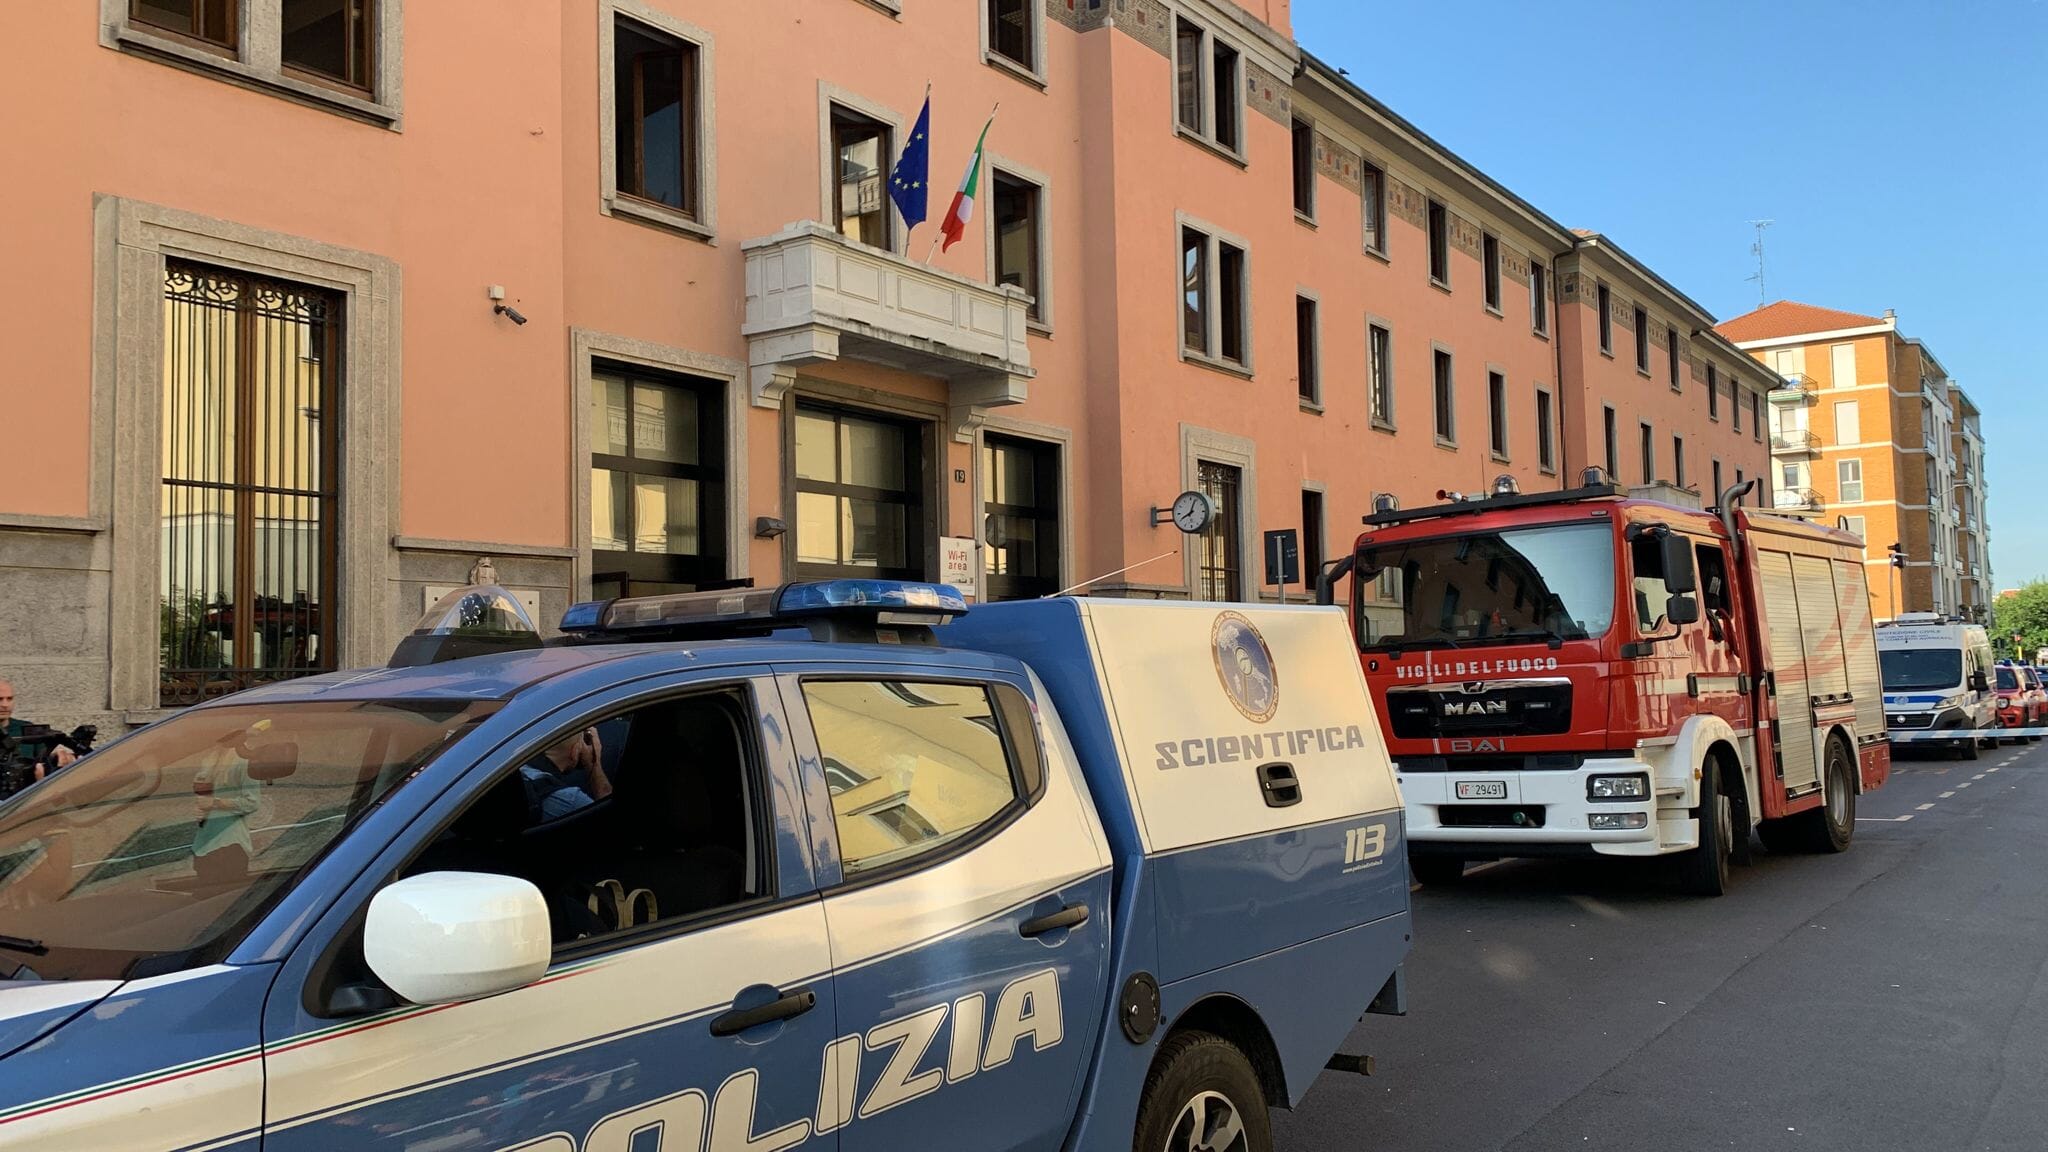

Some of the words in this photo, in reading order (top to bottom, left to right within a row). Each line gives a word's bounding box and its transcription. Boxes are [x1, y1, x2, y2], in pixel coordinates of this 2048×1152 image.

[956, 471, 964, 482] 19
[948, 550, 968, 561] Wi-Fi
[948, 562, 967, 571] area
[1396, 664, 1451, 679] VIGILI
[1455, 660, 1491, 675] DEL
[1496, 656, 1557, 673] FUOCO
[1444, 700, 1507, 716] MAN
[1451, 739, 1505, 752] BAI
[1459, 784, 1470, 795] VF
[1475, 784, 1502, 795] 29491
[492, 967, 1064, 1152] OLIZIA
